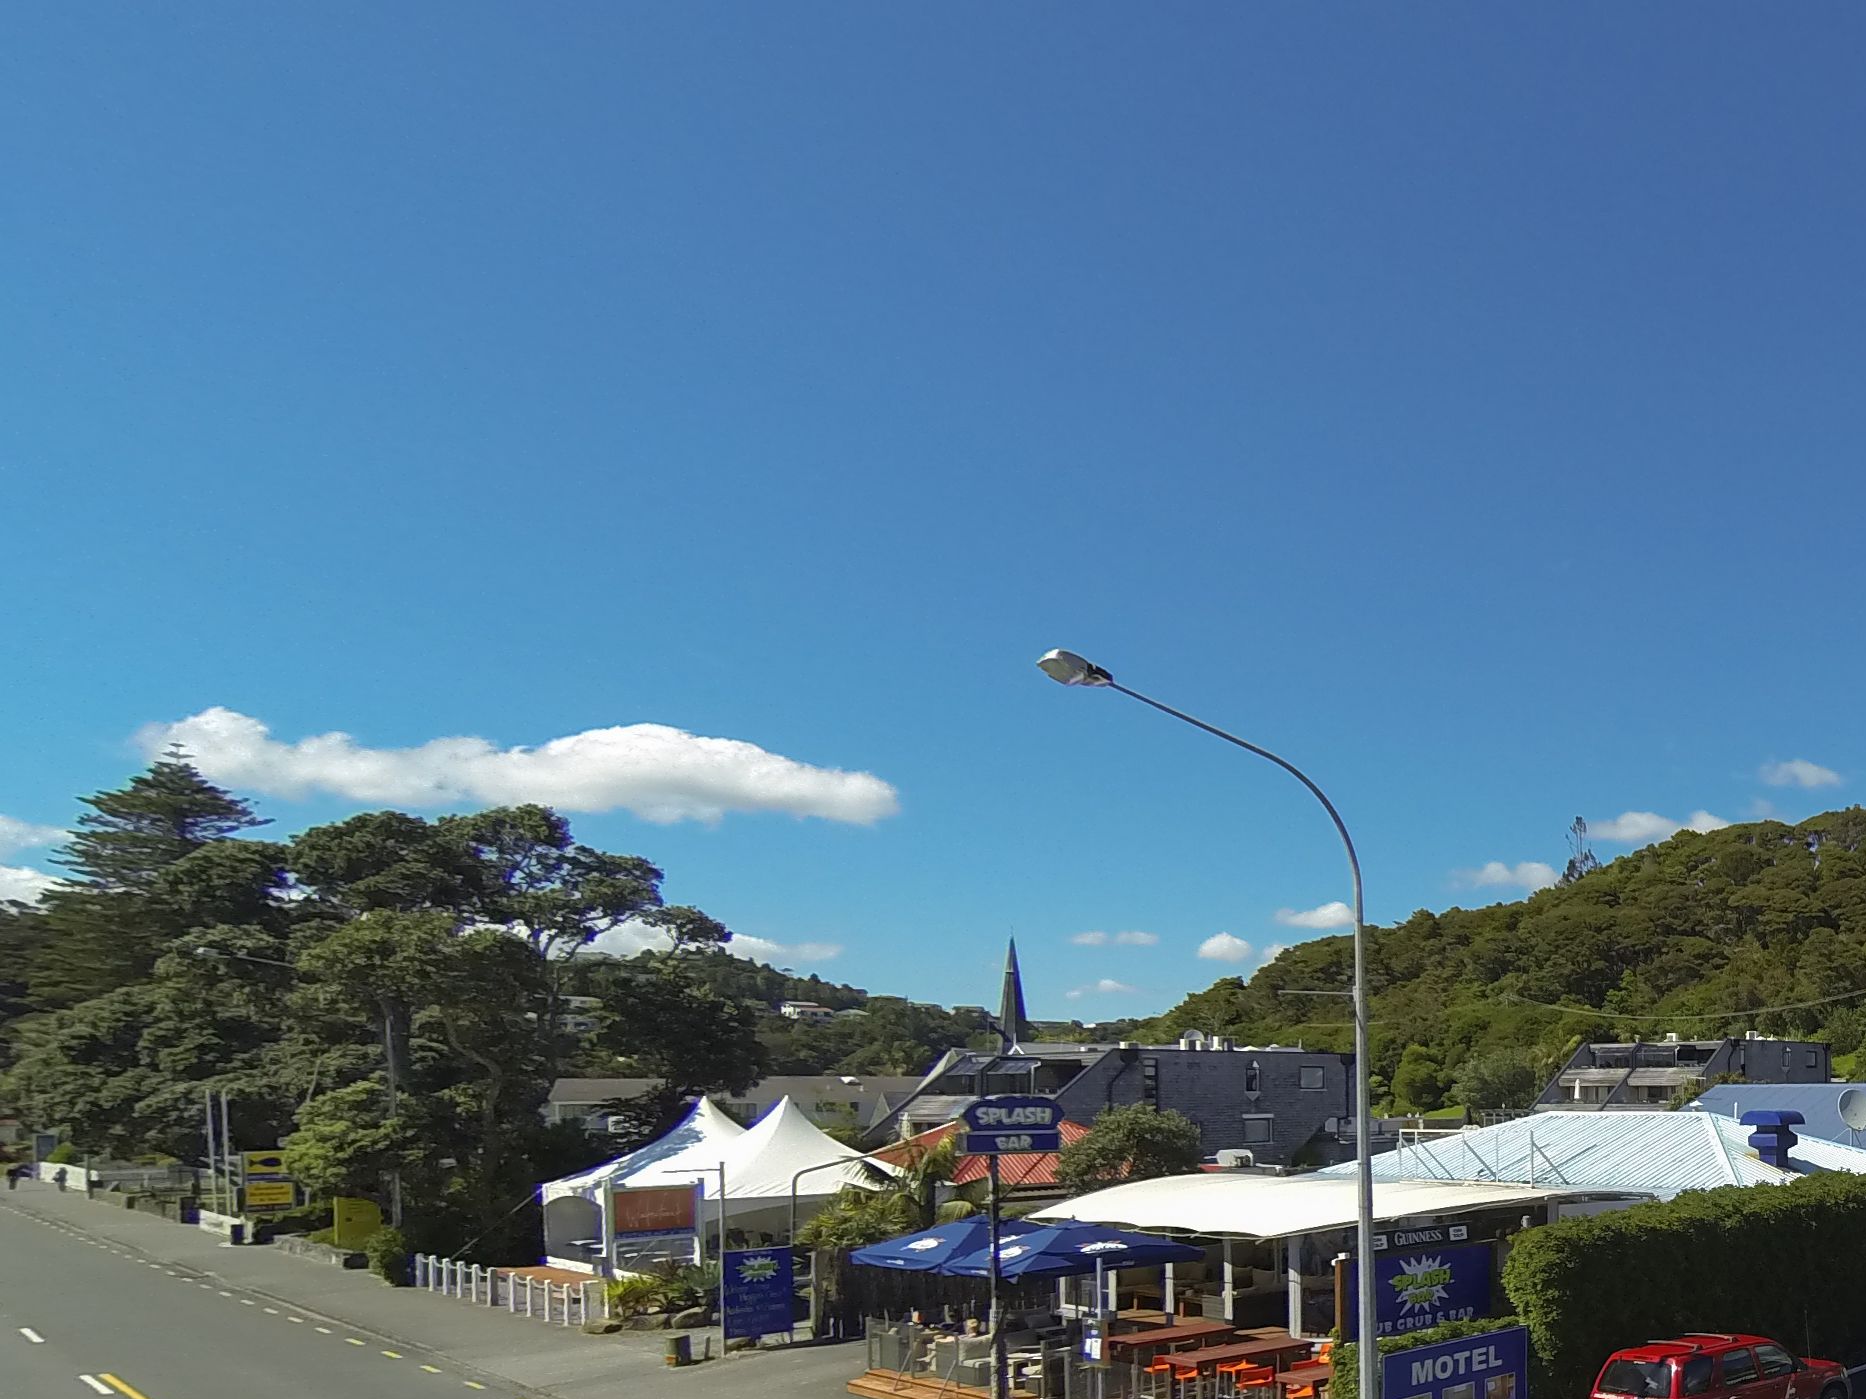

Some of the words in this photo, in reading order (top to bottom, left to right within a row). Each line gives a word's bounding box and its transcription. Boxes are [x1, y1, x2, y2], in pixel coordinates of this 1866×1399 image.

[975, 1106, 1053, 1126] SPLASH
[995, 1135, 1033, 1150] BAR
[1394, 1229, 1443, 1246] GUINNESS
[1391, 1268, 1452, 1292] SPLASH
[1396, 1314, 1433, 1330] GRUB
[1449, 1306, 1474, 1320] BAR
[1411, 1345, 1503, 1386] MOTEL
